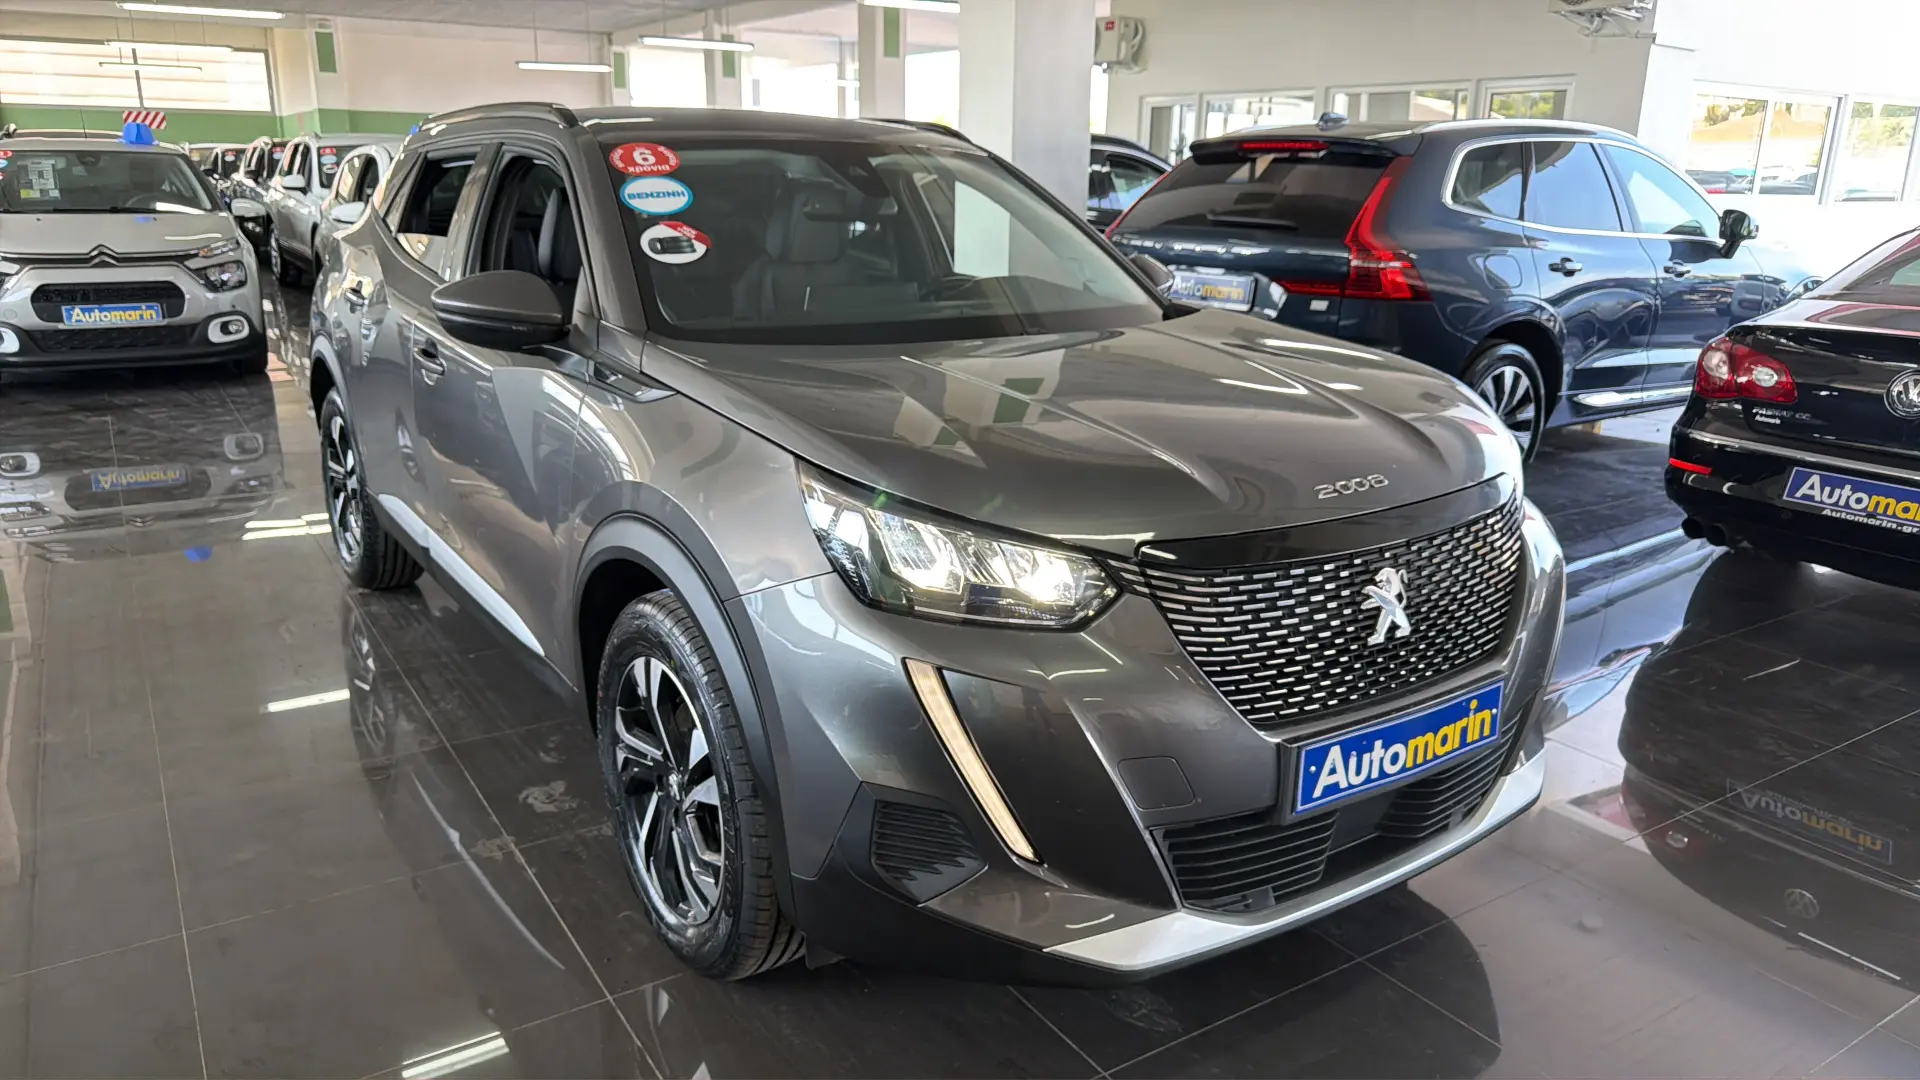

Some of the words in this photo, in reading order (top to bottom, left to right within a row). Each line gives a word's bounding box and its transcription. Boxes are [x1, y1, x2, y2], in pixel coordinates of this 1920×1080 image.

[632, 147, 656, 165] 6
[71, 304, 156, 323] Automarin
[1313, 474, 1389, 499] 2008
[1794, 474, 1920, 521] Automa
[1821, 508, 1920, 533] Automarin.gr
[1312, 699, 1492, 799] Automarin
